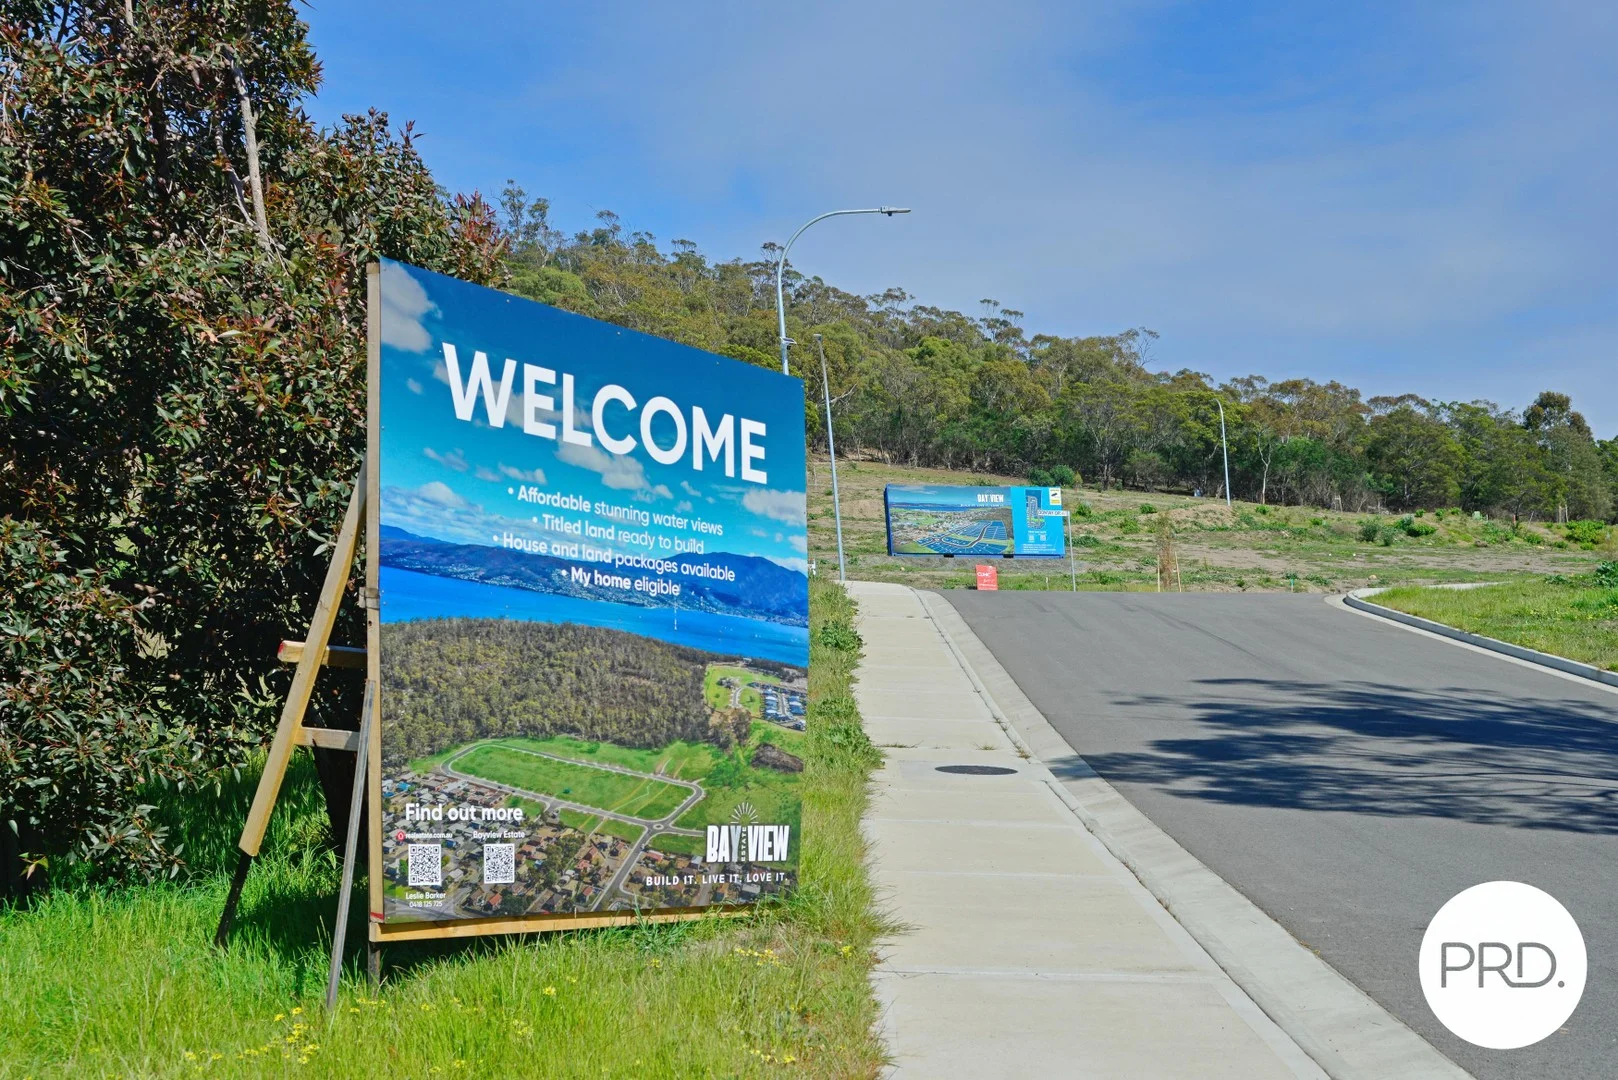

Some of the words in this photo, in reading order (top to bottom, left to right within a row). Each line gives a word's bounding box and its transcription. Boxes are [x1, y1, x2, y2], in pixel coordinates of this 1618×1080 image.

[442, 342, 767, 485] WELCOME
[518, 485, 591, 512] Affordable
[594, 501, 649, 526] stunning
[652, 513, 688, 530] water
[691, 517, 723, 536] views
[542, 513, 581, 534] Titled
[585, 521, 614, 540] land
[618, 530, 655, 550] ready
[658, 535, 671, 549] to
[674, 536, 704, 554] build
[503, 531, 548, 554] House
[551, 543, 579, 558] and
[582, 543, 612, 564] land
[615, 553, 678, 575] packages
[681, 562, 735, 582] available
[571, 566, 591, 587] My
[594, 570, 631, 589] home
[634, 576, 680, 597] eligible
[405, 803, 442, 821] Find
[447, 805, 477, 821] out
[481, 807, 523, 821] more
[473, 831, 502, 840] Bayview
[503, 831, 525, 839] Estate
[706, 825, 742, 863] BAY
[747, 825, 790, 862] VIEW
[405, 892, 424, 900] Leslie
[425, 891, 446, 900] Barker
[646, 876, 680, 886] BUILD
[684, 875, 697, 885] IT.
[702, 874, 725, 884] LIVE
[729, 873, 742, 883] IT.
[747, 872, 772, 883] LOVE
[776, 872, 788, 882] IT.
